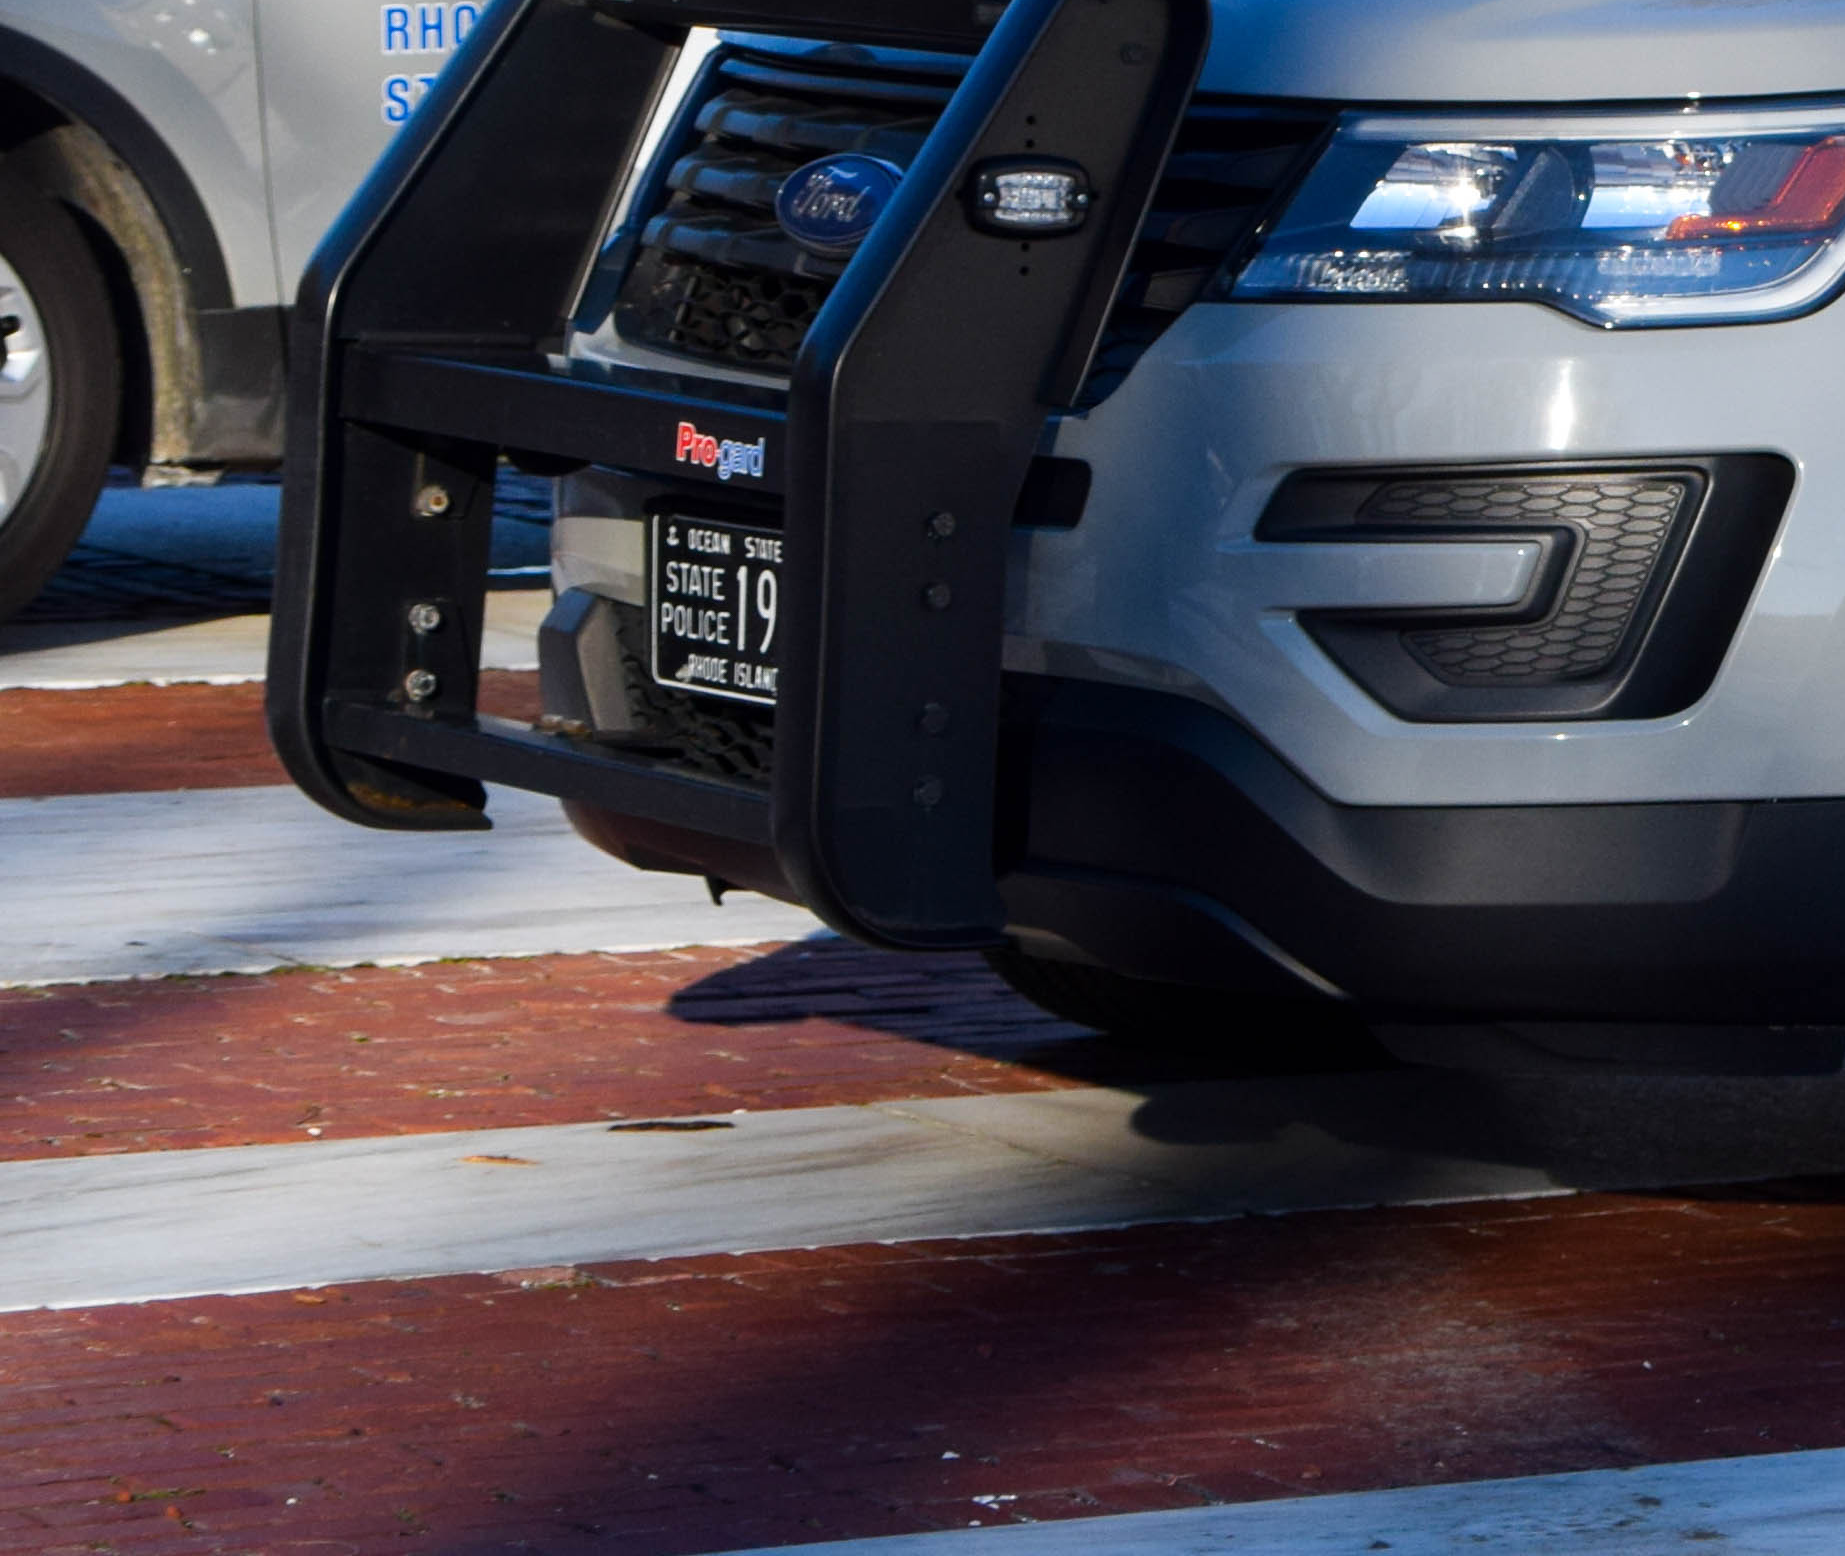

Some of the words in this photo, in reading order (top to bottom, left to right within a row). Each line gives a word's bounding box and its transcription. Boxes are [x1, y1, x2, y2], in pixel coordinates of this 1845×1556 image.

[381, 0, 484, 55] RHO
[791, 166, 872, 222] Ford
[687, 527, 731, 555] OCEAN
[744, 536, 783, 563] STATE
[665, 561, 726, 601] STATE
[661, 602, 730, 645] POLICE
[736, 565, 778, 654] 19
[687, 653, 729, 684] RHODE
